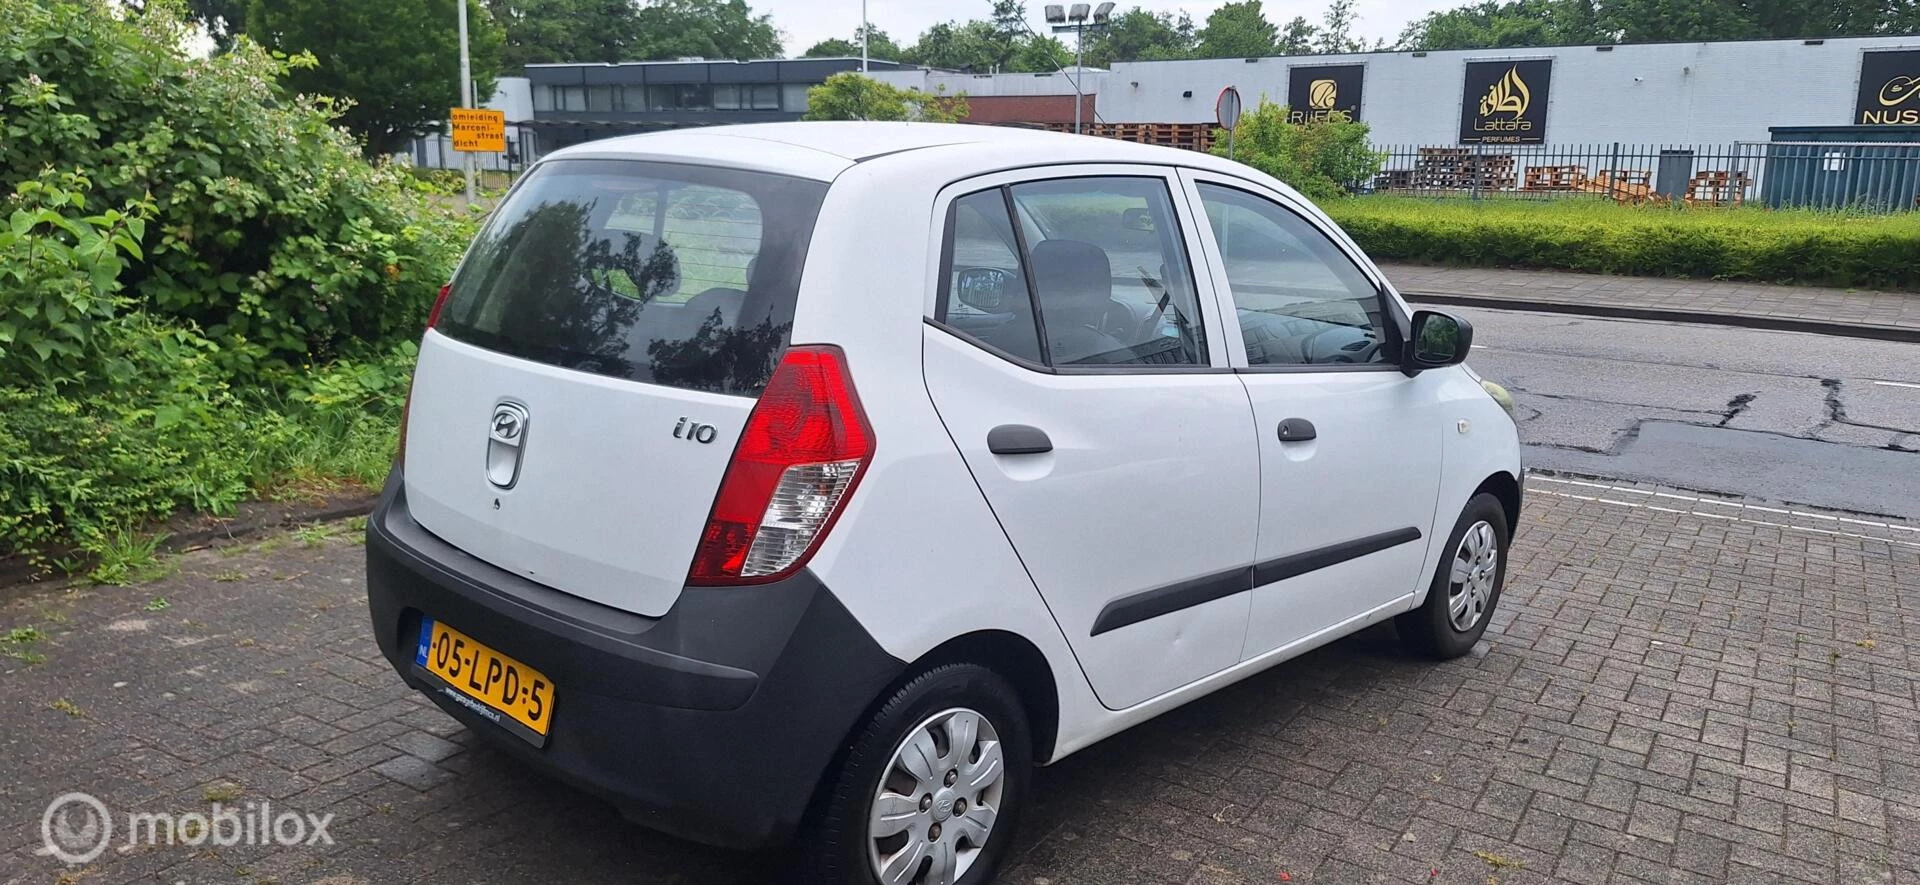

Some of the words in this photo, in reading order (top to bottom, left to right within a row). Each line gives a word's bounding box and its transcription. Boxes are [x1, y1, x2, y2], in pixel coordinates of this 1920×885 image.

[1474, 117, 1532, 131] Lattafa
[673, 416, 718, 444] i10
[418, 644, 428, 658] NL
